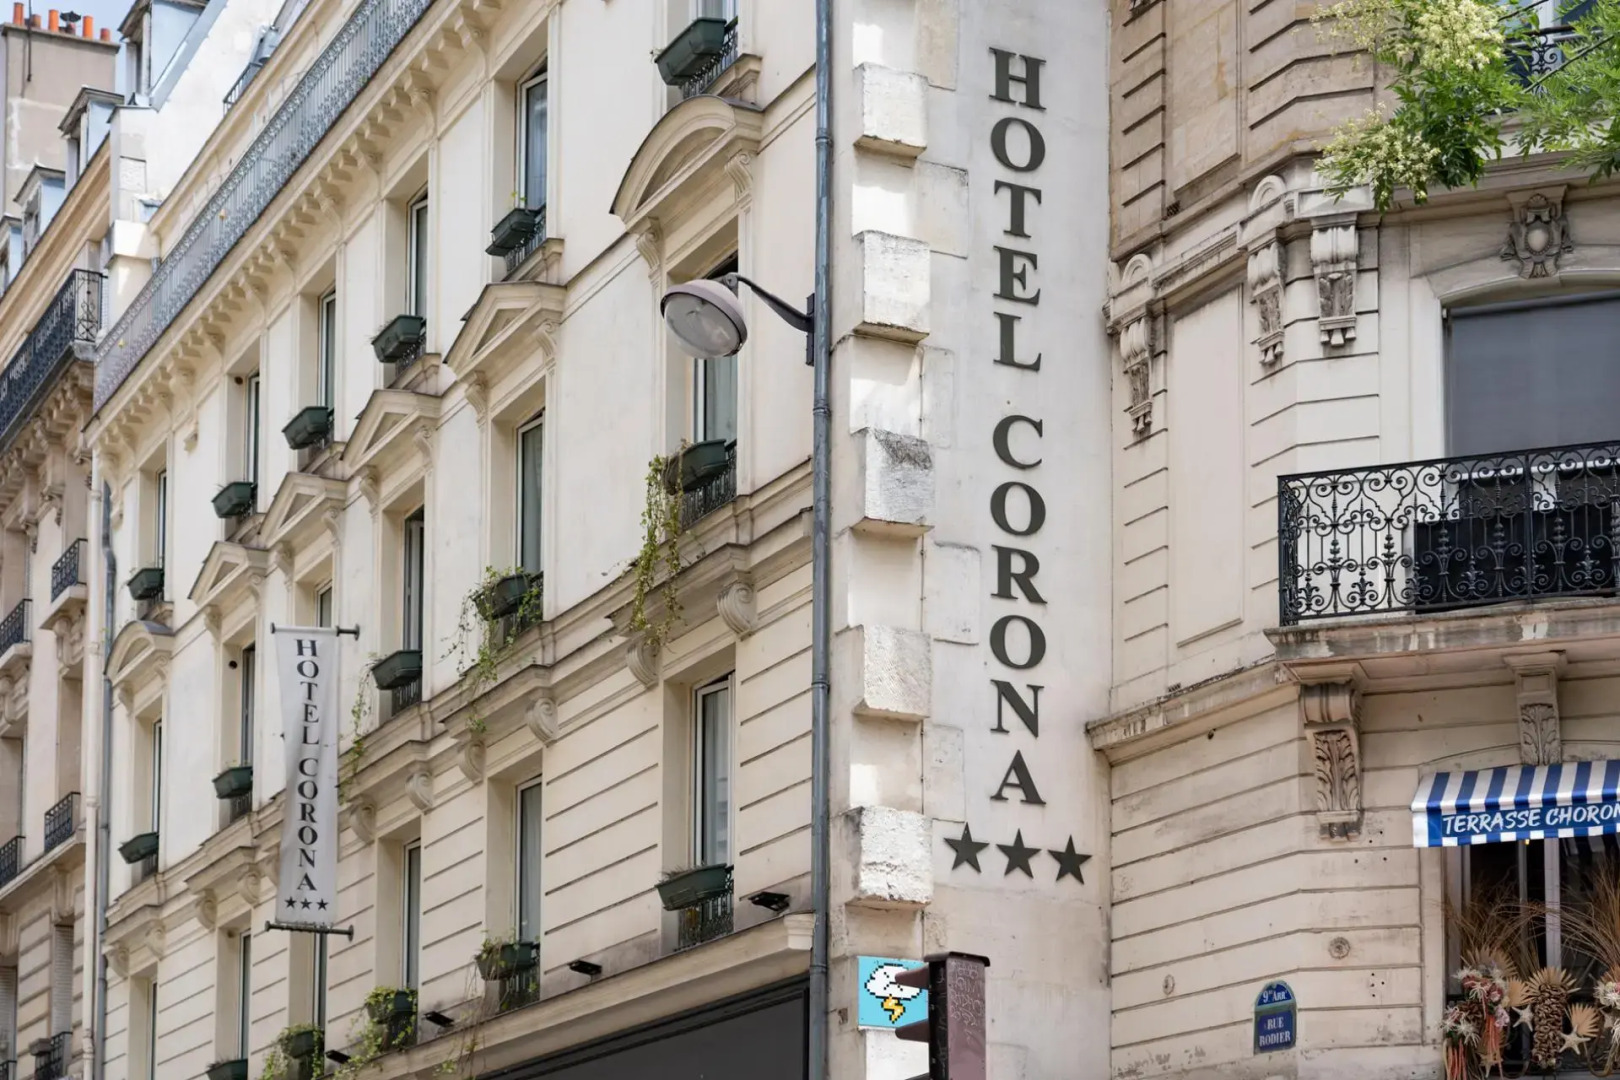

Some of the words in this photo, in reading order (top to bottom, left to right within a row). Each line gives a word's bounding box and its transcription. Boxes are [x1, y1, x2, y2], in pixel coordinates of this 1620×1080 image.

[988, 46, 1047, 372] HOTEL
[989, 414, 1048, 805] CORONA
[296, 639, 320, 745] HOTEL
[297, 758, 318, 891] CORONA
[1443, 808, 1541, 834] TERRASSE
[1259, 1030, 1291, 1047] RODIER
[1267, 1017, 1284, 1030] RUE
